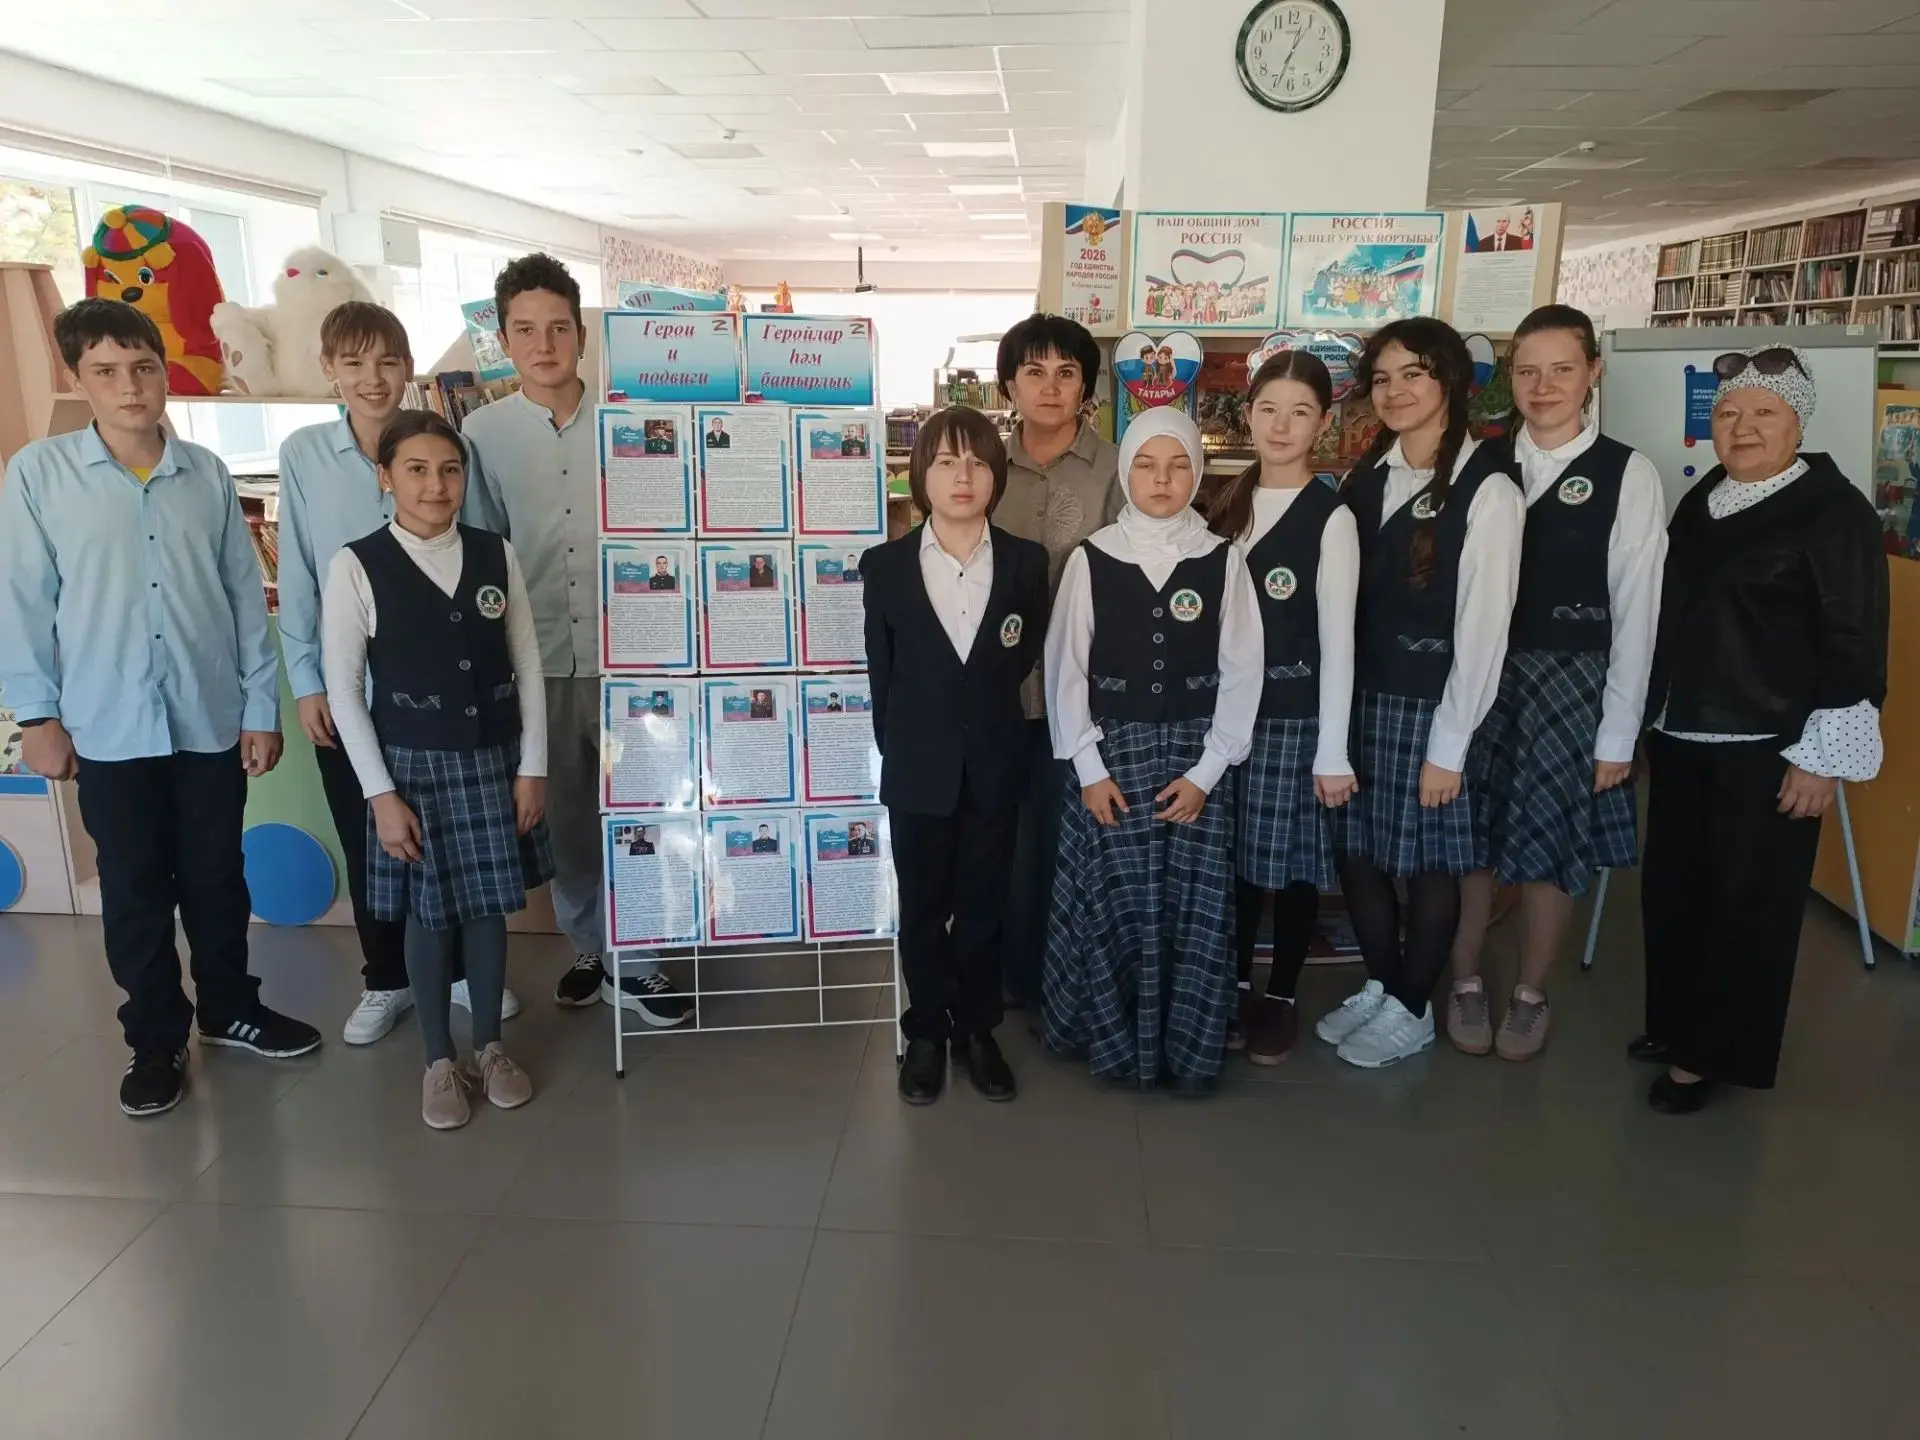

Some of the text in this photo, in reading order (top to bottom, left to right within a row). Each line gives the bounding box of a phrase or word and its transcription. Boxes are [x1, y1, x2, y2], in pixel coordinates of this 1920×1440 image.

[1274, 15, 1283, 30] 11
[1288, 10, 1300, 25] 12
[1308, 14, 1313, 29] 1
[1260, 29, 1273, 43] 10
[1318, 26, 1326, 41] 2
[1254, 46, 1262, 60] 9
[1321, 44, 1331, 58] 3
[1259, 63, 1268, 77] 8
[1315, 61, 1324, 74] 4
[1271, 74, 1279, 88] 7
[1286, 78, 1295, 92] 6
[1302, 73, 1311, 88] 5
[1157, 217, 1260, 229] НАШ ОБЩИЙ ДОМ
[1332, 217, 1394, 229] РОССИЯ
[1181, 232, 1242, 244] РОССИЯ
[1080, 248, 1107, 261] 2026
[1070, 262, 1115, 272] ГОД ЕДИНСТВА
[1066, 271, 1119, 281] НАРОДОВ РОССИИ
[643, 320, 695, 339] Герои
[762, 323, 843, 345] Геройлар
[668, 349, 678, 361] и
[639, 370, 709, 386] подвиги
[760, 371, 852, 391] батырлык
[1138, 387, 1176, 399] ТАТАРЫ
